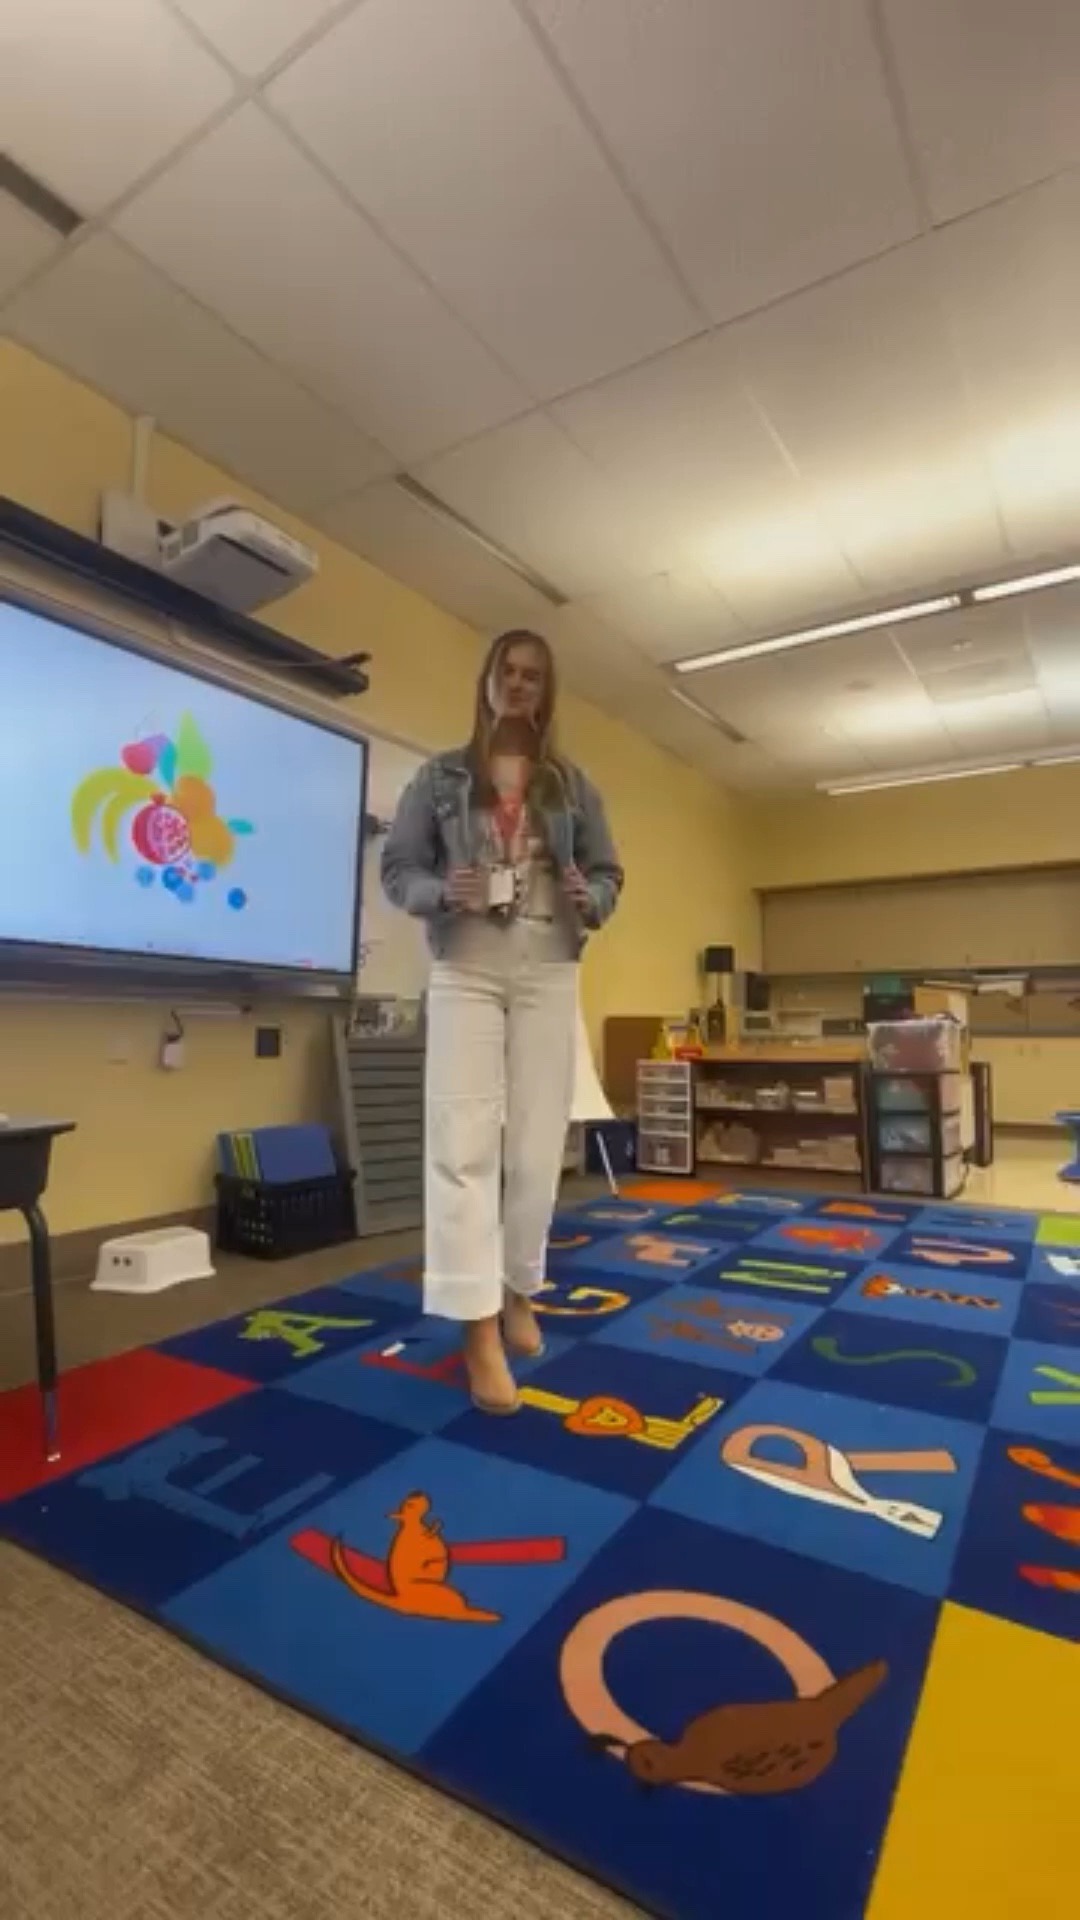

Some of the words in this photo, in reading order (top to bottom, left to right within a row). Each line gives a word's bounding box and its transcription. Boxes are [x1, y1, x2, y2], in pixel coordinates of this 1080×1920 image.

[721, 1258, 848, 1294] N
[238, 1309, 375, 1357] A
[810, 1336, 978, 1387] S
[516, 1386, 724, 1451] L
[76, 1425, 336, 1542] E
[721, 1423, 957, 1540] R
[288, 1489, 568, 1624] K
[559, 1588, 888, 1796] Q
